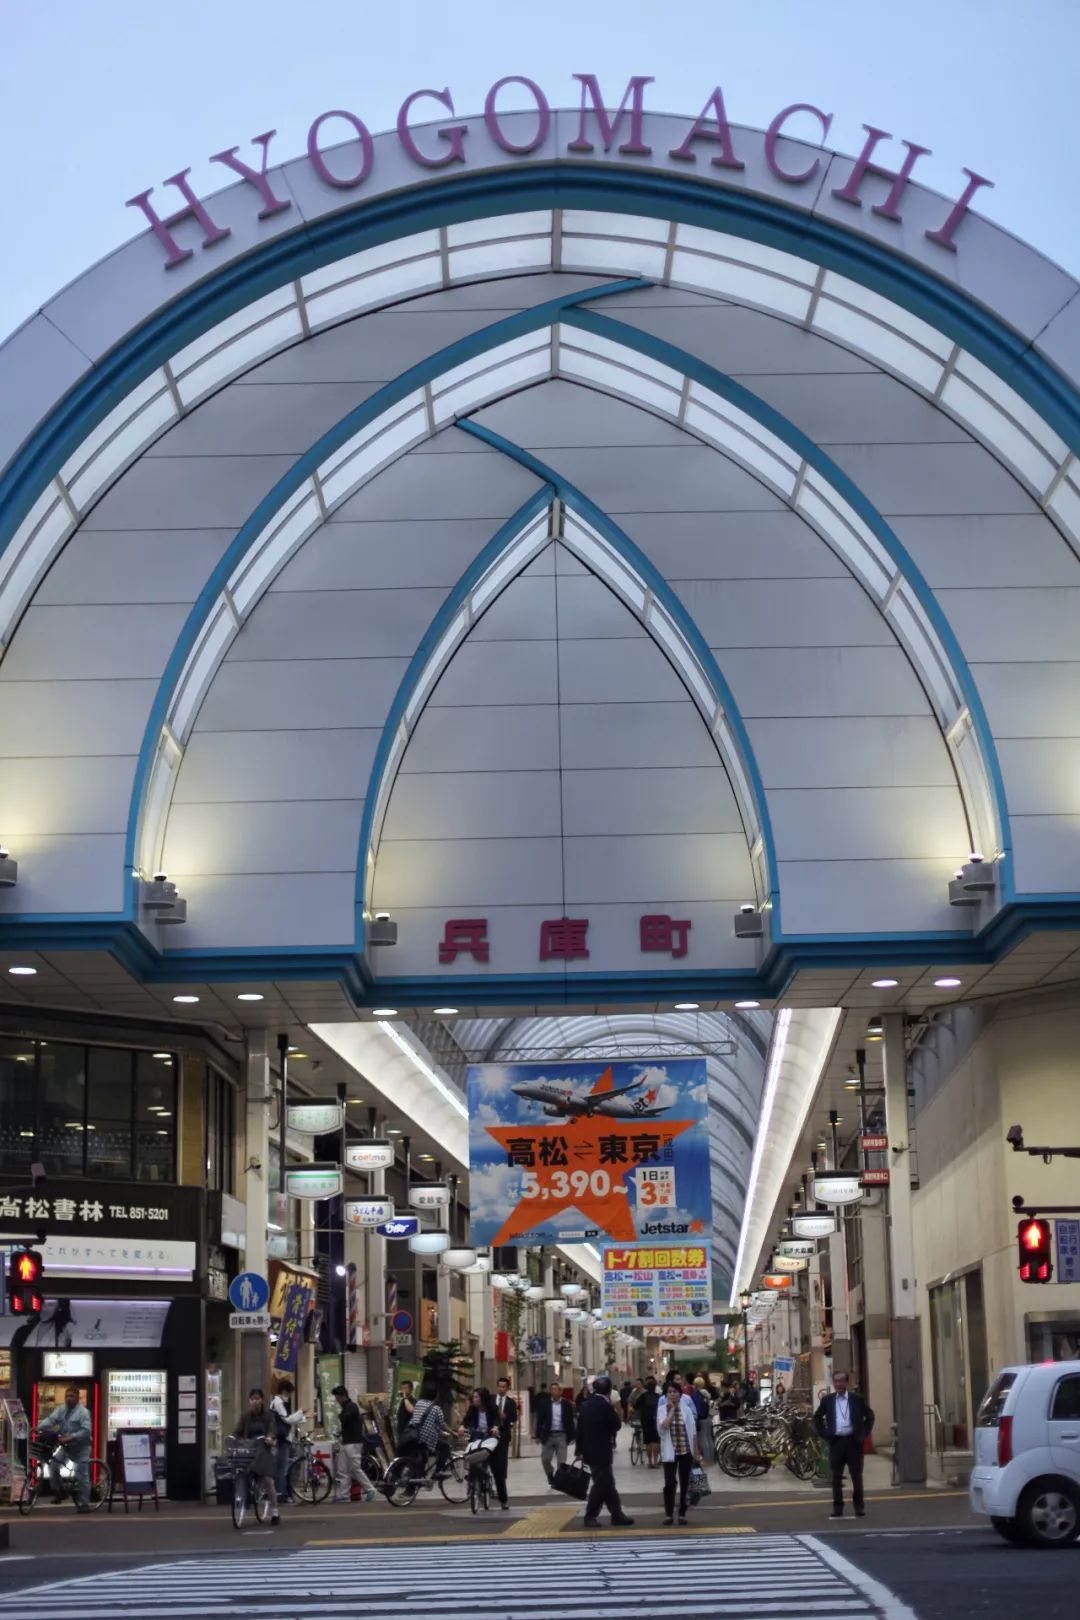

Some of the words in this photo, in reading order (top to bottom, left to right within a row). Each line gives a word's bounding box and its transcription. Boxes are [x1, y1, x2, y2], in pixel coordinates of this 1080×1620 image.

[126, 73, 996, 271] HYOGOMACHI
[438, 914, 691, 964] 兵庫町
[506, 1136, 568, 1167] 高松
[598, 1133, 660, 1164] 東京
[642, 1170, 658, 1181] 1日
[640, 1181, 657, 1206] 3
[0, 1195, 104, 1222] 高松書林
[109, 1205, 128, 1218] TEL
[641, 1222, 689, 1234] Jetstar
[607, 1248, 705, 1269] トク割回数券
